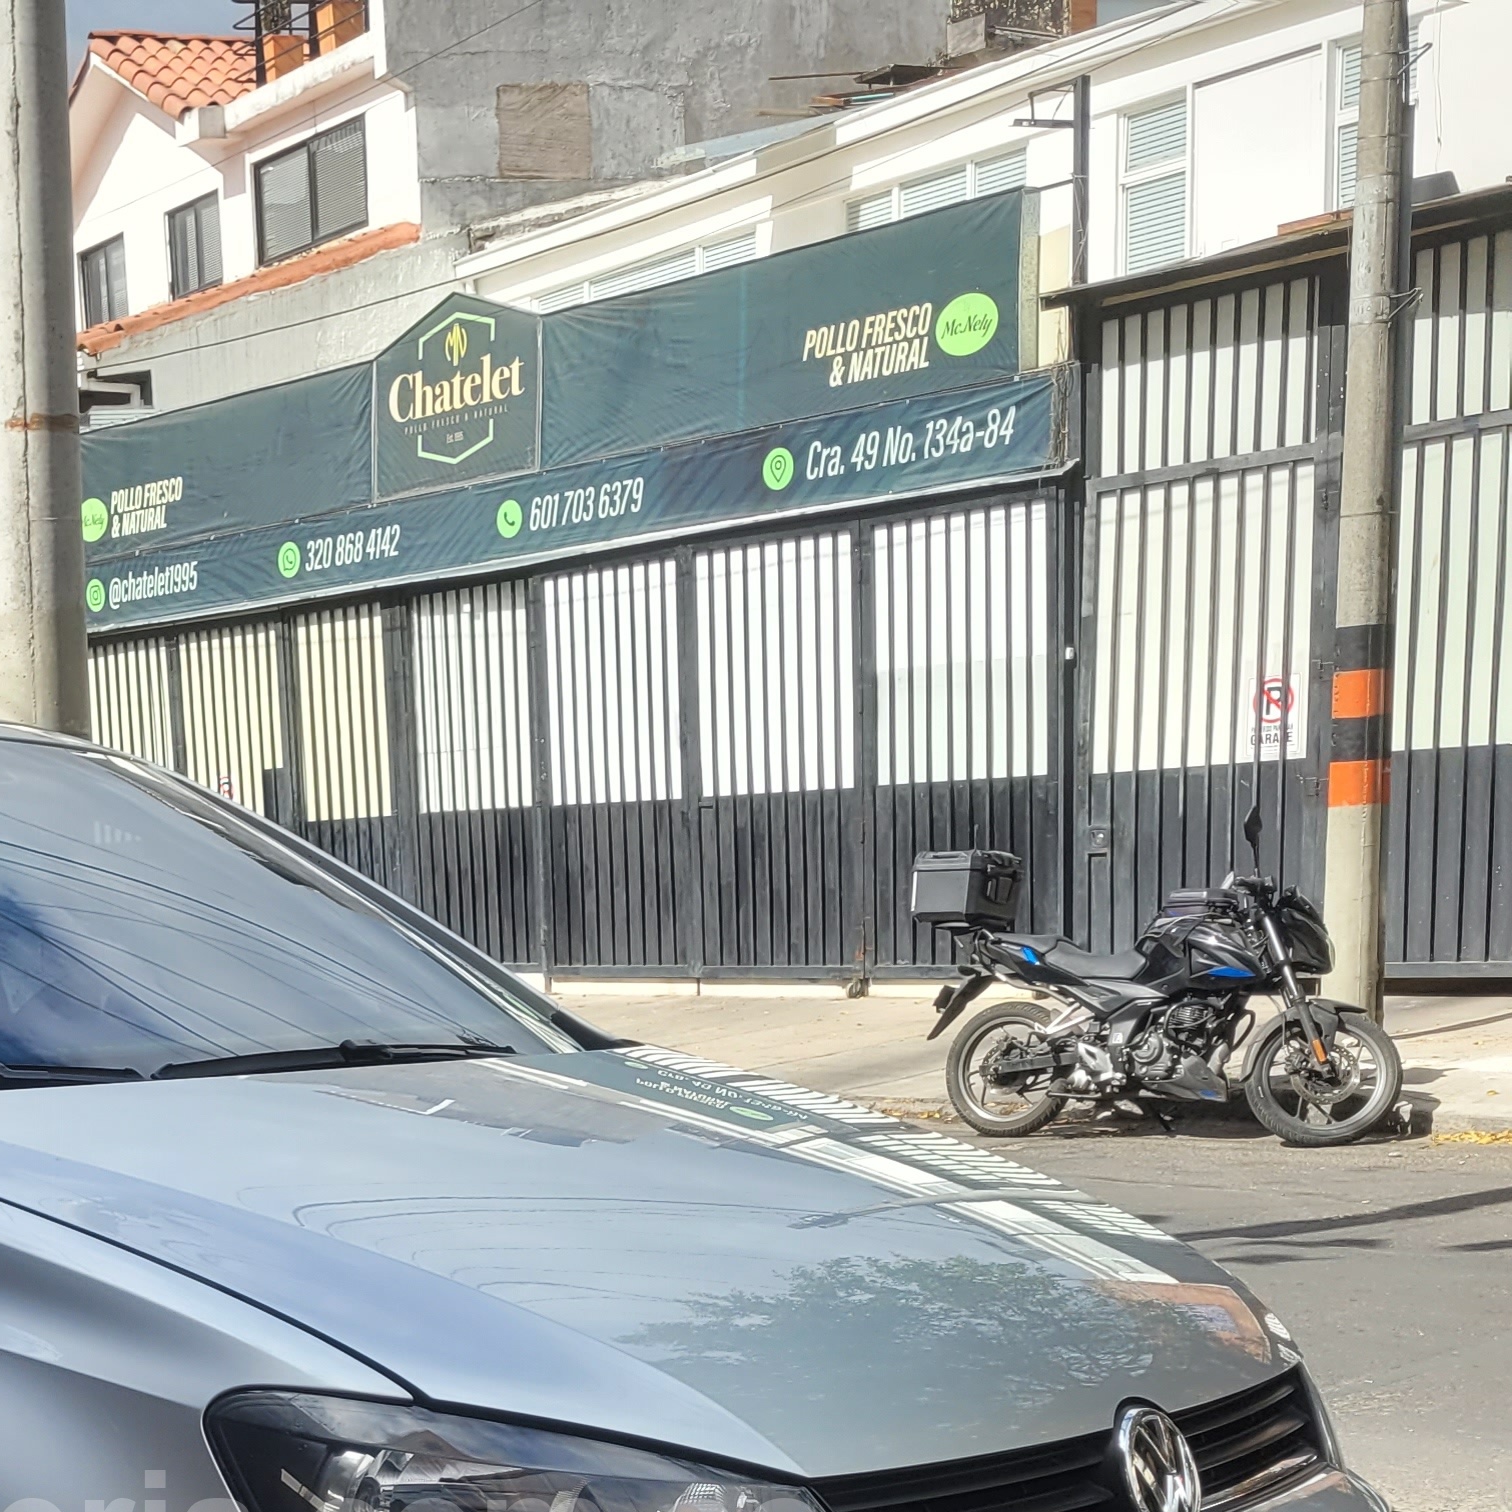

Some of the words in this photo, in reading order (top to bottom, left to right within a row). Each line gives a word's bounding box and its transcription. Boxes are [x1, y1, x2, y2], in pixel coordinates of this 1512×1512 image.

[802, 319, 860, 361] POLLO
[861, 302, 933, 348] FRESCO
[829, 356, 845, 387] &
[847, 336, 929, 384] NATURAL
[389, 353, 525, 423] Chatelet
[806, 441, 844, 480] Cra.
[850, 431, 879, 472] 49
[882, 425, 916, 467] No.
[923, 405, 1016, 460] 134a-84
[110, 485, 143, 514] POLLO
[143, 477, 183, 508] FRESCO
[530, 493, 560, 531] 601
[562, 486, 595, 526] 703
[598, 477, 644, 519] 6379
[111, 514, 121, 538] &
[121, 505, 167, 536] NATURAL
[305, 537, 333, 572] 320
[335, 531, 364, 566] 868
[366, 524, 401, 560] 4142
[109, 561, 198, 610] @chatelet1995
